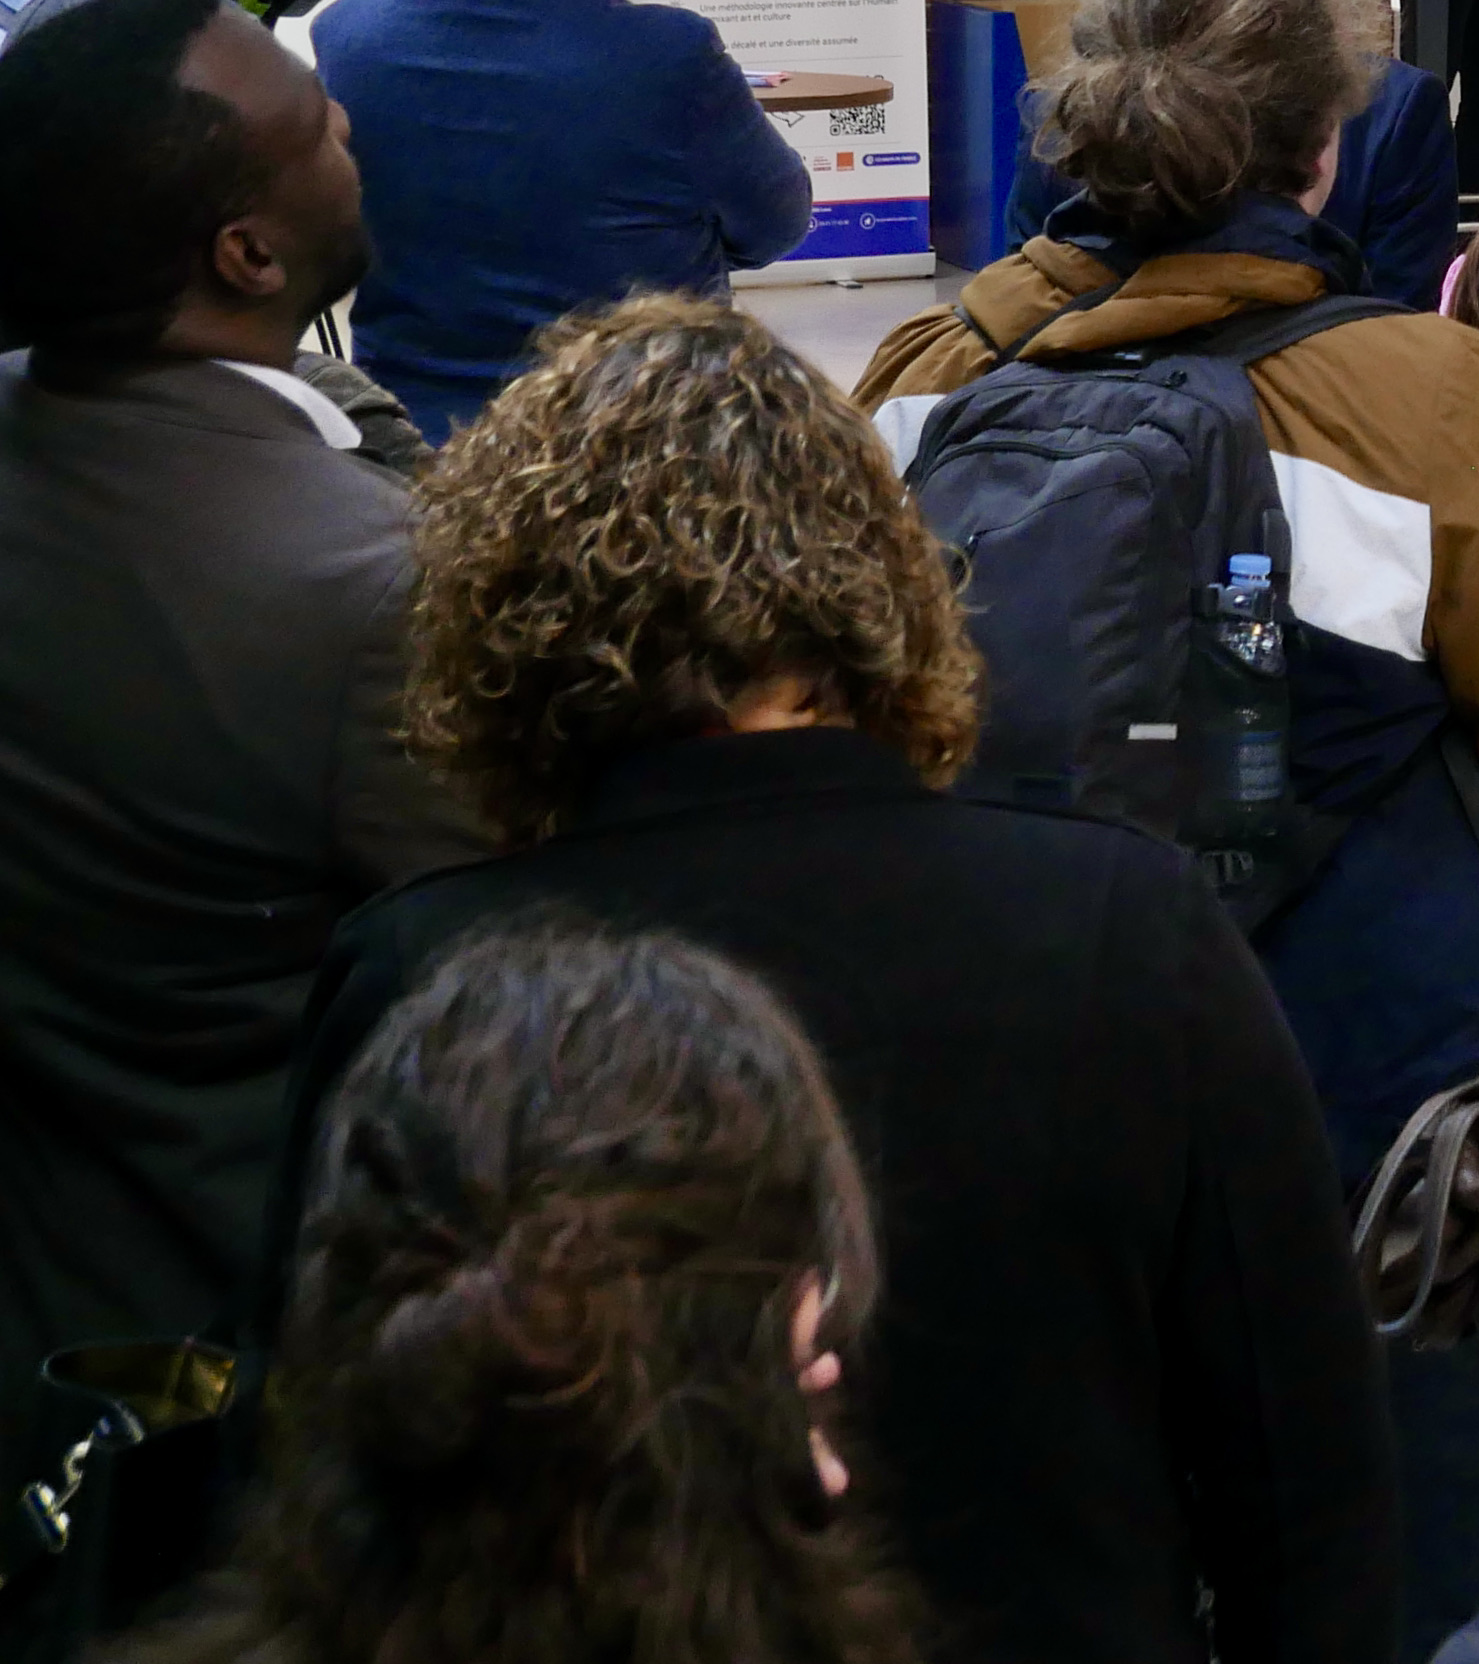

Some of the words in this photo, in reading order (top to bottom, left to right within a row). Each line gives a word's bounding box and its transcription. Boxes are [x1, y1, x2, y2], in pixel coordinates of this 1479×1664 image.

[731, 39, 758, 50] décalé
[768, 38, 785, 48] une
[785, 36, 821, 47] diversité
[822, 36, 859, 46] assumée
